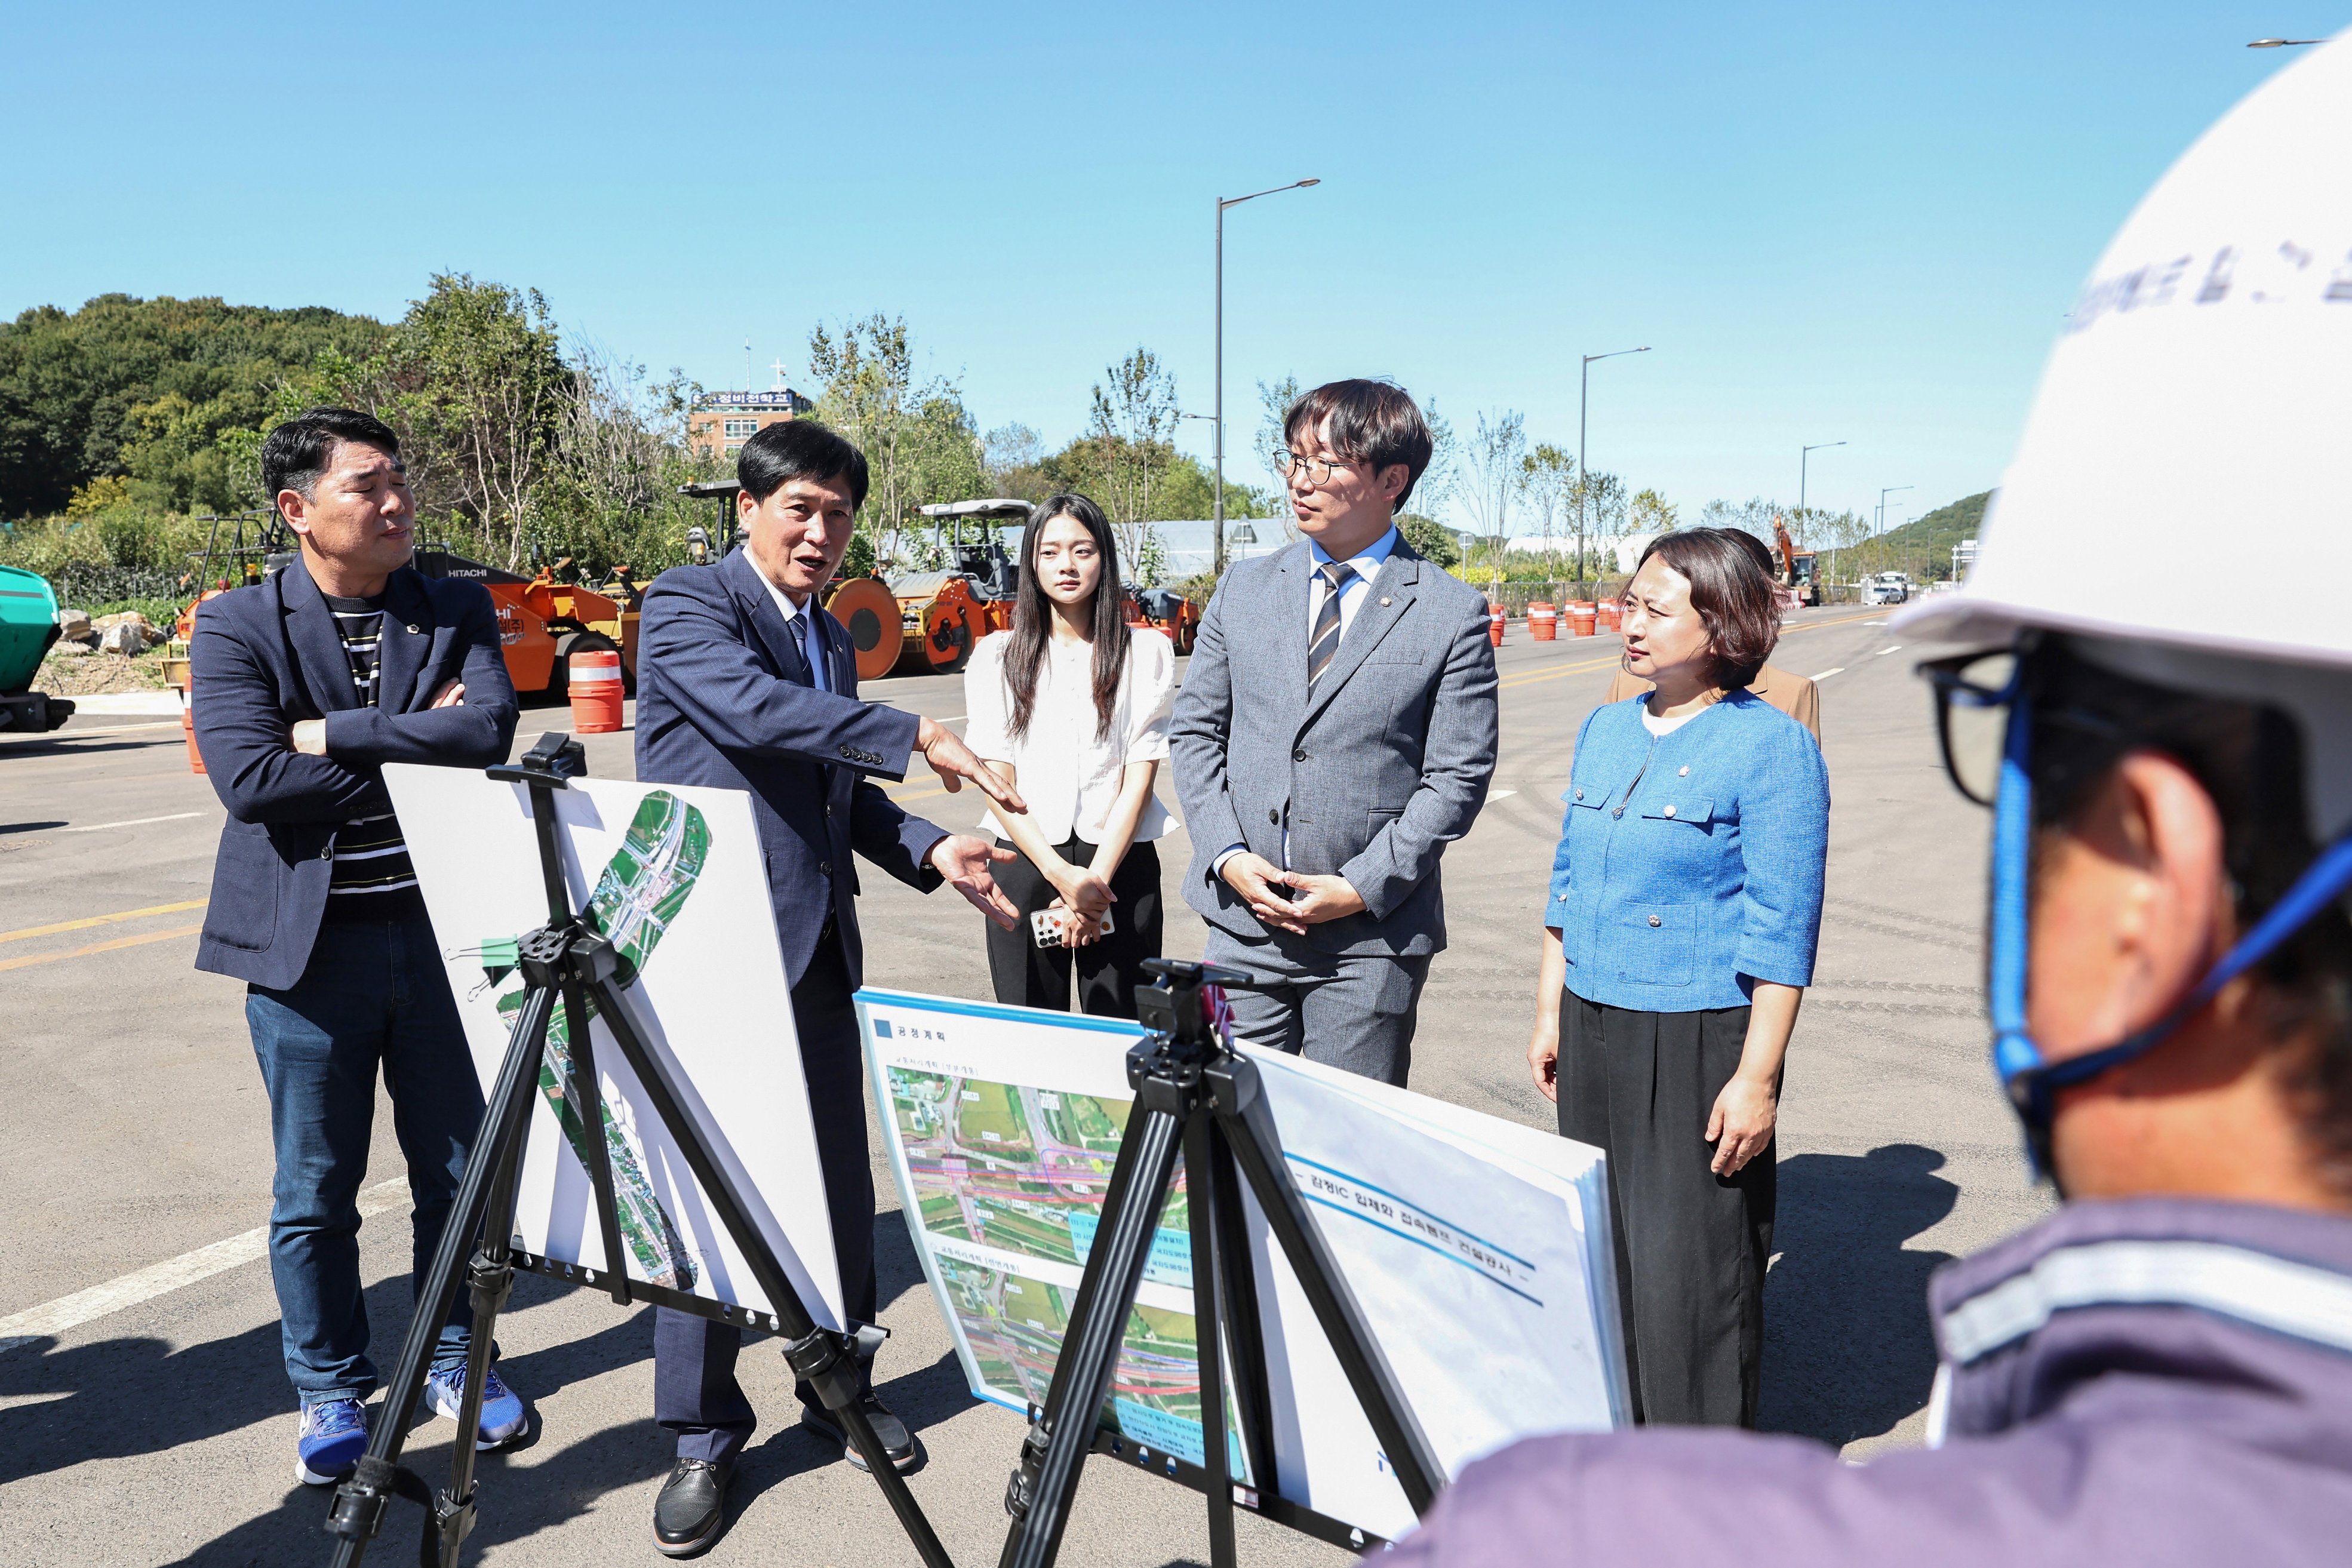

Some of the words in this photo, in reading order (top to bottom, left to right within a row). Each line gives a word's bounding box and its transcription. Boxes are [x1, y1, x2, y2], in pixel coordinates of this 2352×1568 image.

[705, 393, 789, 404] 정비전학교
[448, 569, 487, 577] HITACHI
[496, 608, 511, 619] HI
[498, 619, 524, 633] 설(주)
[897, 1026, 946, 1042] 공정계획
